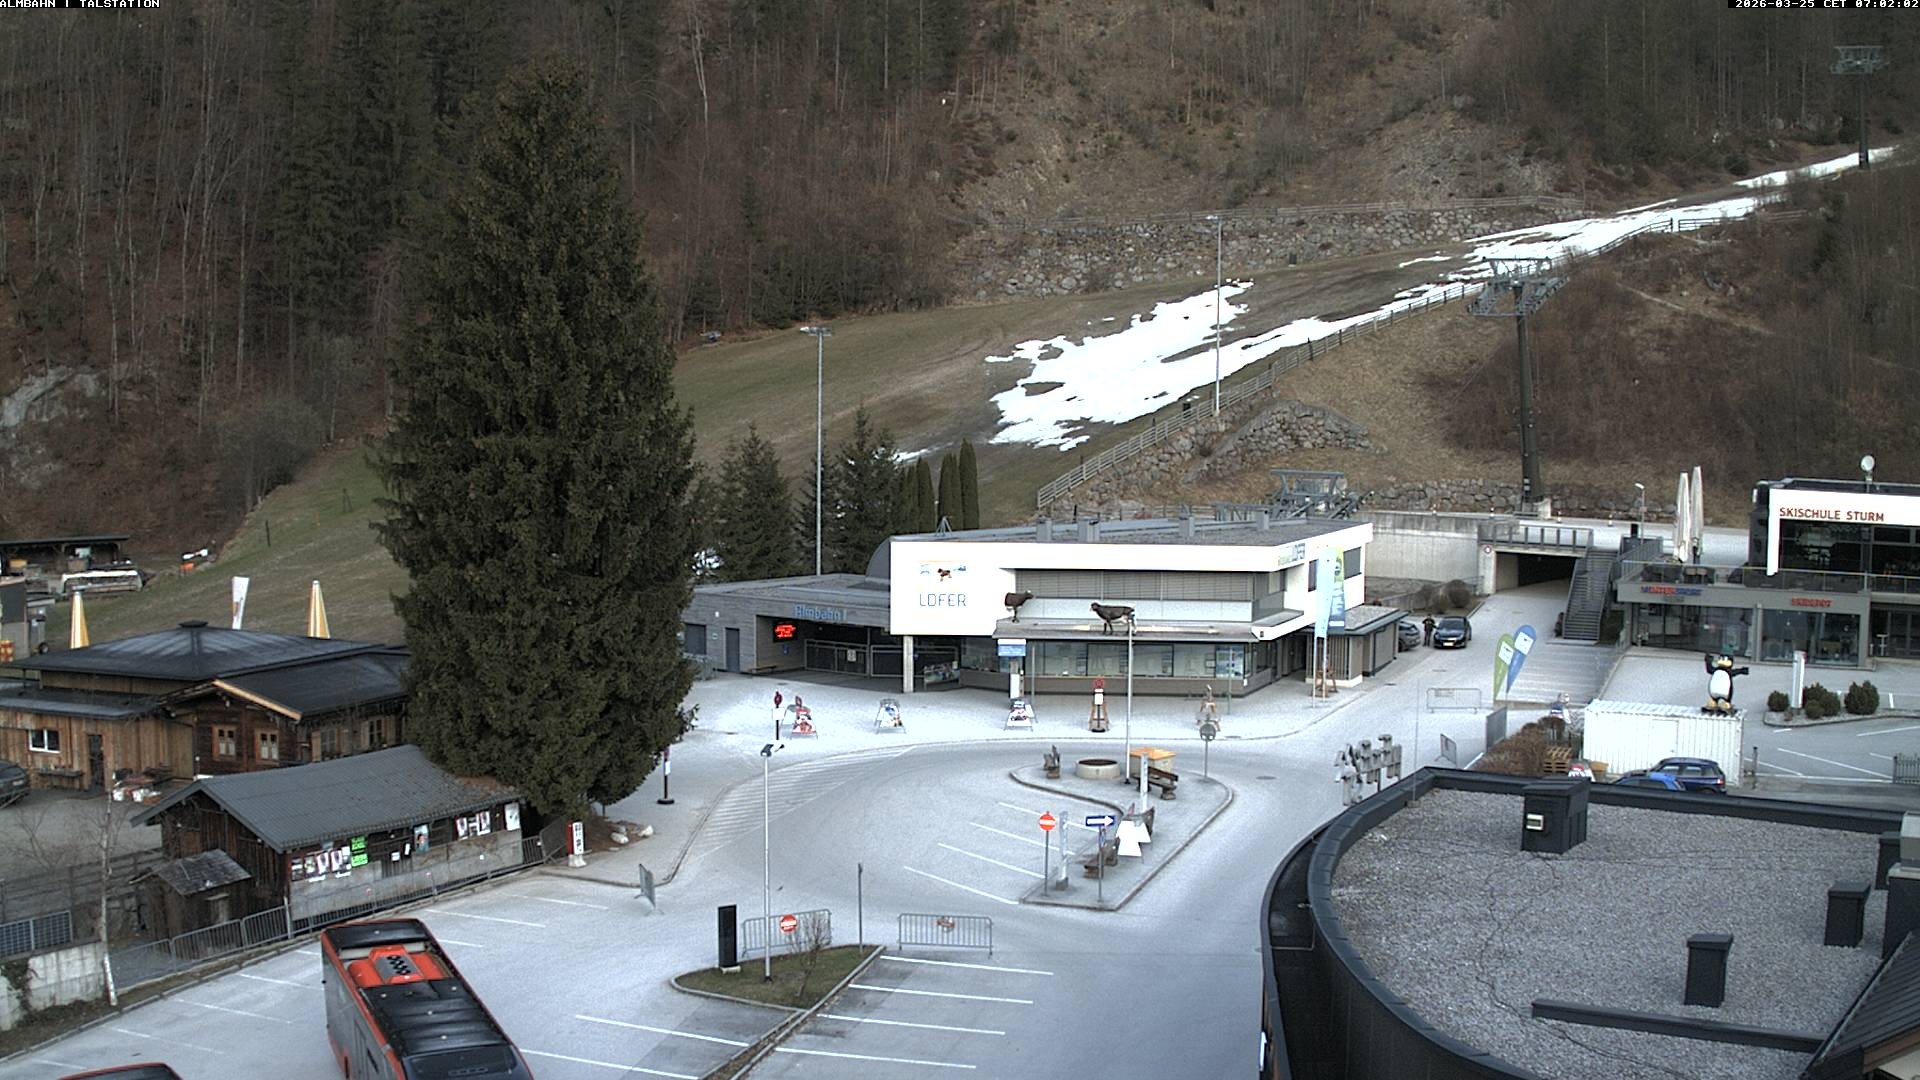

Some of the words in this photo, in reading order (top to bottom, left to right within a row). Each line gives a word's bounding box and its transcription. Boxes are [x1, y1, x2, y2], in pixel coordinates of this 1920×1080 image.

[1779, 507, 1841, 520] SKISCHULE
[1846, 510, 1885, 522] STURM
[919, 593, 967, 607] LOFER
